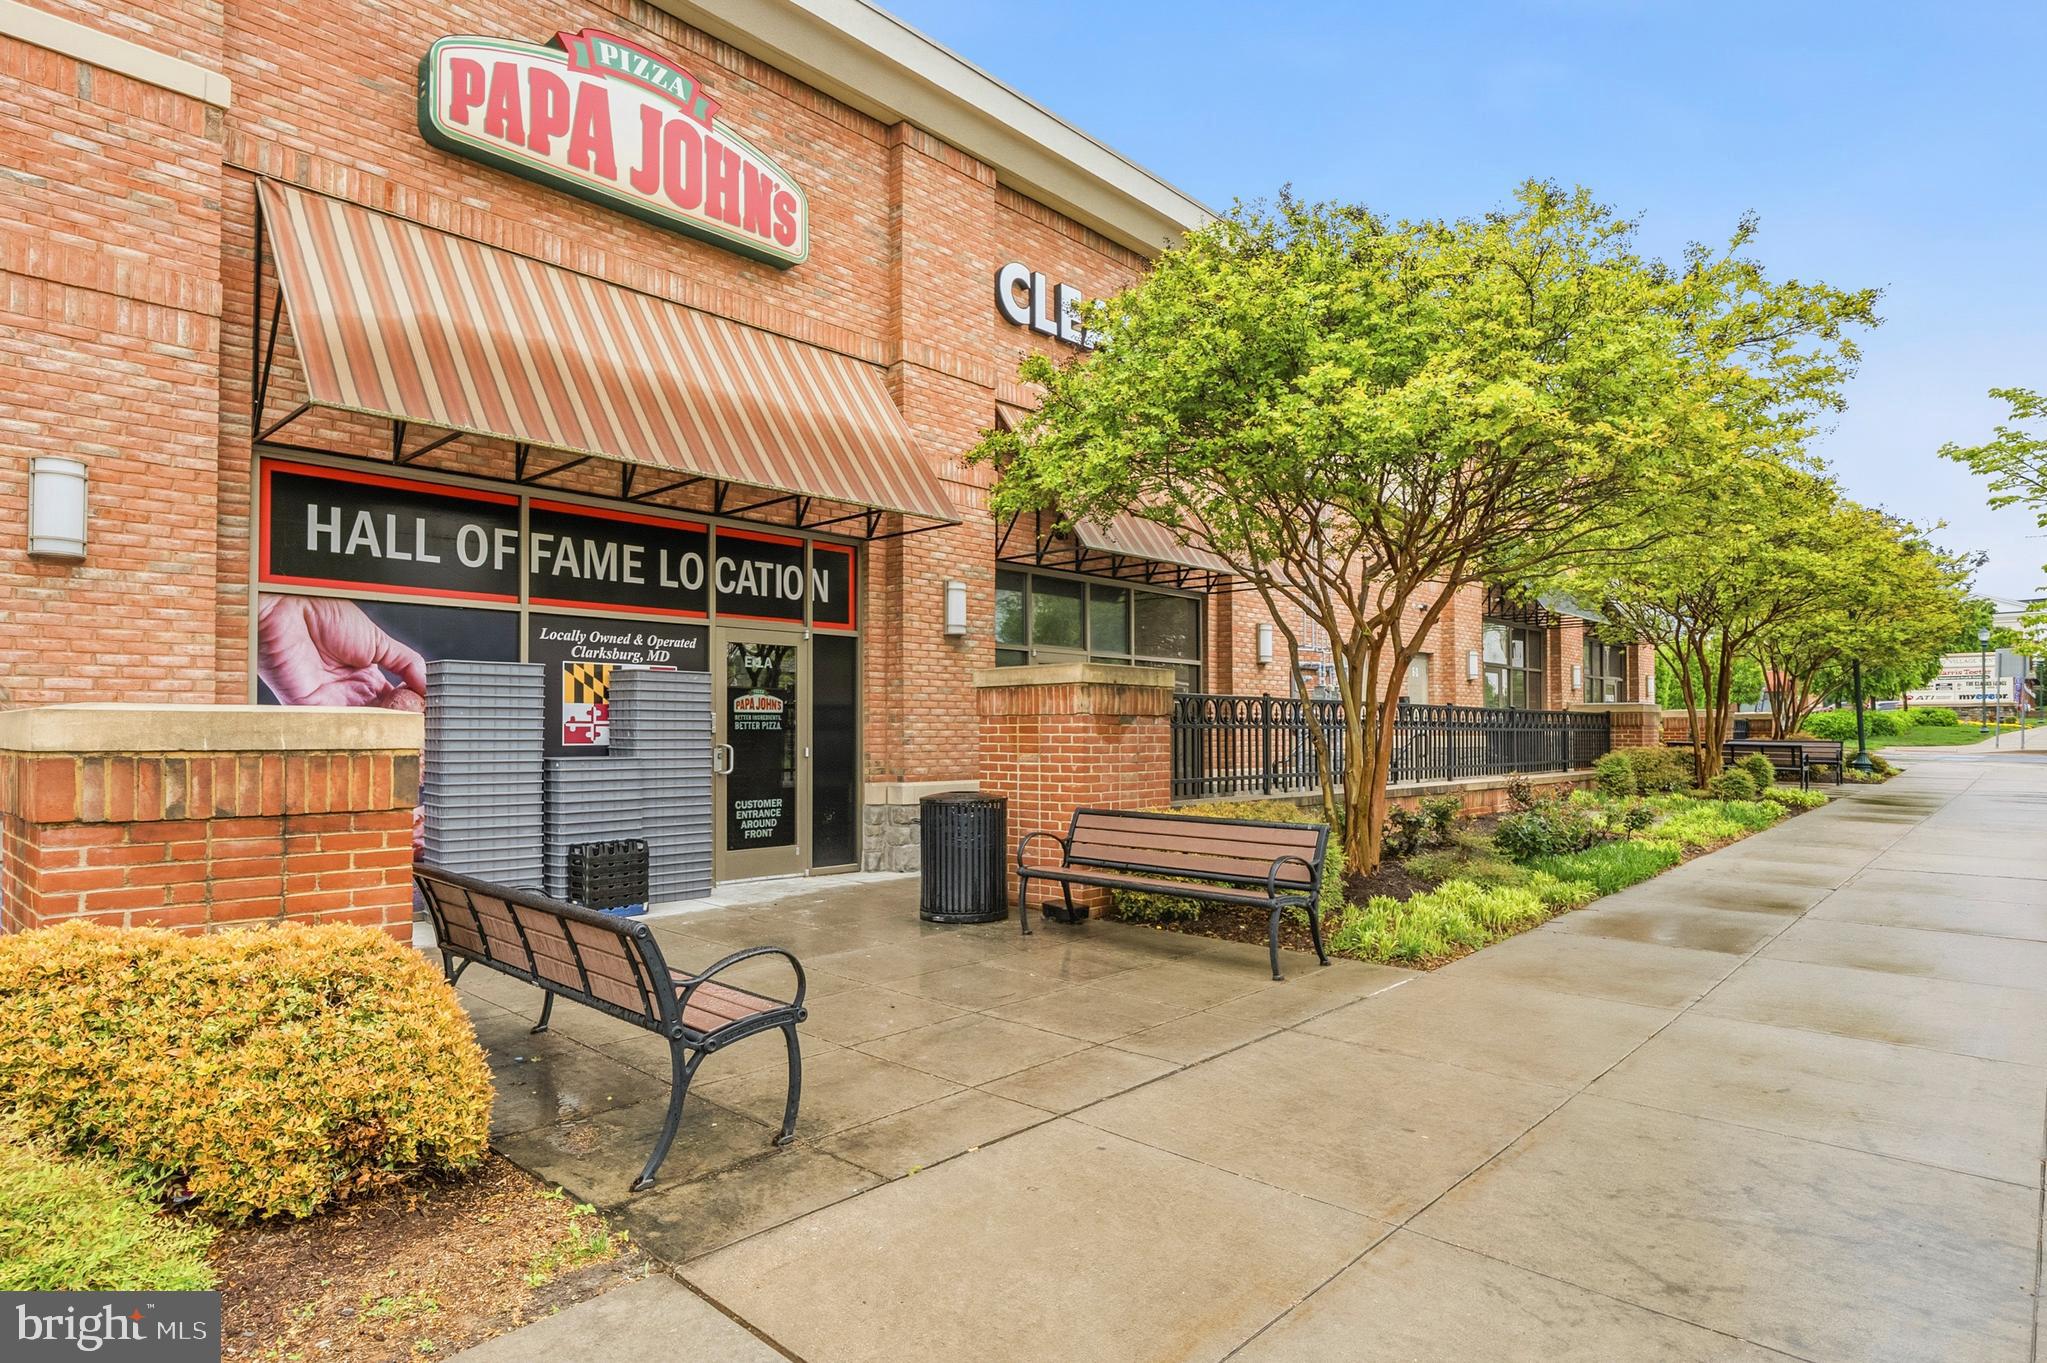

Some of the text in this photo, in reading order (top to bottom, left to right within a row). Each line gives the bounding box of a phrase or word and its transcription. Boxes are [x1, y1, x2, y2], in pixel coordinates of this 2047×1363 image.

[600, 38, 689, 101] PIZZA
[449, 57, 797, 247] PAPA JOHN'S
[995, 261, 1094, 350] CLE
[307, 503, 829, 602] HALL OF FAME LOCATION
[539, 627, 697, 649] Locally Owned & Operated
[571, 645, 670, 663] Clarksburg, MD
[735, 698, 755, 710] PAPA
[735, 721, 760, 730] BETTER
[735, 798, 783, 809] CUSTOMER
[736, 808, 782, 820] ENTRANCE
[740, 818, 777, 829] AROUND
[744, 828, 773, 839] FRONT
